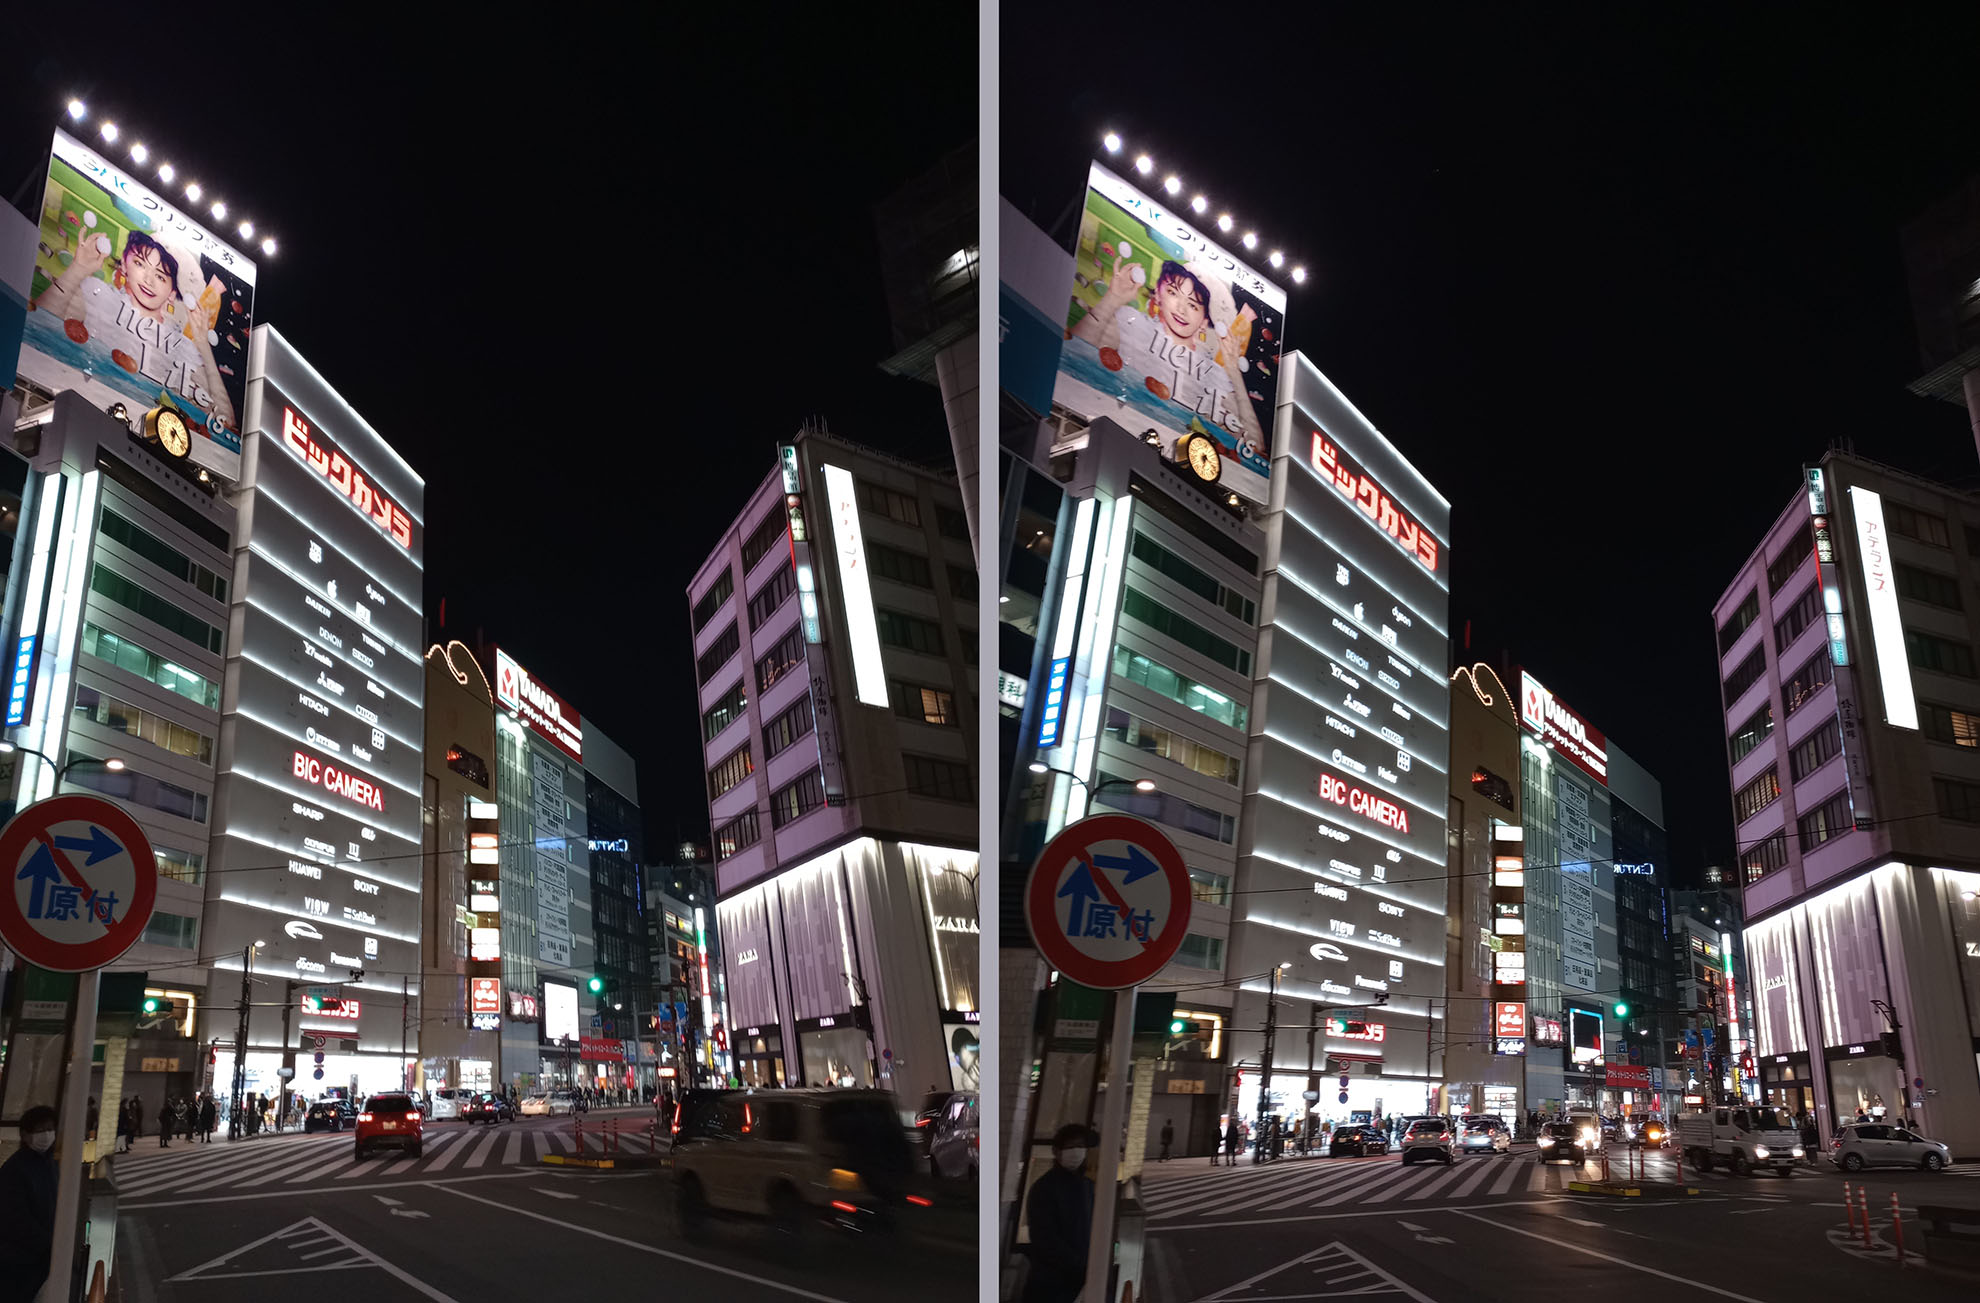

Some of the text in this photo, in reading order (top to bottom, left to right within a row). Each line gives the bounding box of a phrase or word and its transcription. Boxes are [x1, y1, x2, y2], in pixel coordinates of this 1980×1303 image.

[116, 300, 183, 354] new
[1149, 329, 1213, 381] new
[284, 407, 412, 550] ビックカメラ
[1312, 432, 1437, 572] ビックカメラ
[319, 626, 342, 648] DENON
[1332, 618, 1358, 640] DAIKIN
[352, 647, 374, 668] SEIKO
[1345, 648, 1369, 670] DENON
[1378, 670, 1400, 689] SEIKO
[299, 693, 329, 717] HITACHI
[518, 667, 561, 722] YAMADA
[1543, 688, 1586, 743] YAMADA
[1325, 715, 1356, 738] HITACHI
[294, 751, 384, 811] BIC CAMERA
[293, 803, 324, 821] SHARP
[1320, 772, 1409, 834] BIC CAMERA
[1318, 824, 1350, 842] SHARP
[289, 860, 322, 880] HUAWEI
[353, 879, 379, 895] SONY
[45, 885, 119, 925] 原付
[1378, 901, 1404, 917] SONY
[351, 908, 376, 925] SoftBank
[935, 916, 979, 934] ZARA
[1084, 903, 1155, 942] 原付
[295, 956, 325, 973] docomo
[330, 951, 362, 968] Panasonic
[738, 949, 758, 965] ZARA
[1765, 975, 1786, 991] ZARA
[748, 1027, 760, 1036] ZARA
[820, 1017, 835, 1027] ZARA
